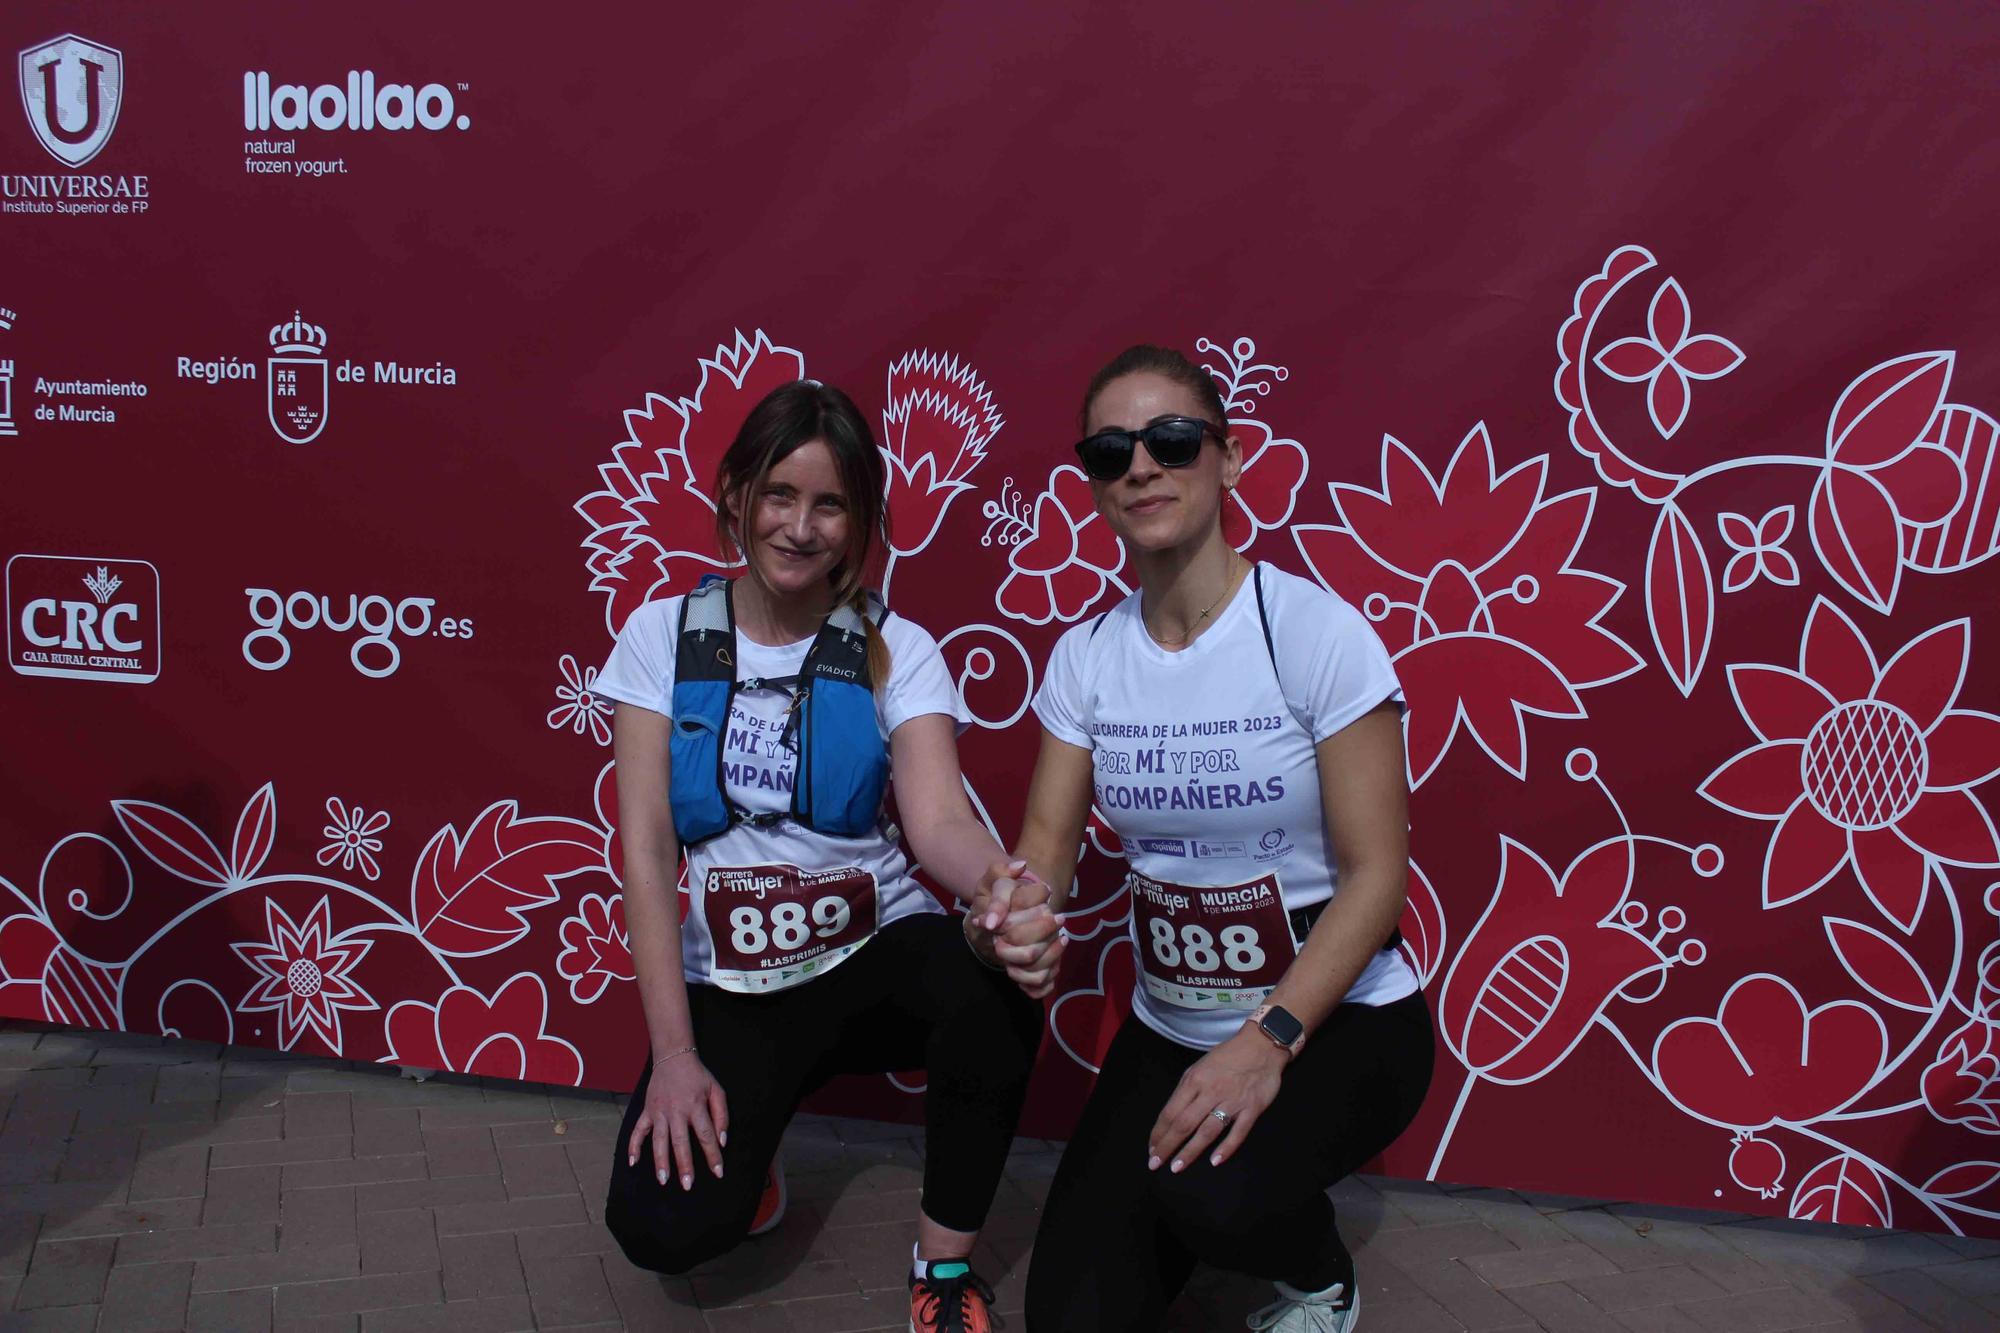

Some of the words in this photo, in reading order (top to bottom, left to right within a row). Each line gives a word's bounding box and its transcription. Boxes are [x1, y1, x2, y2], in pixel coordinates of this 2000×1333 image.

[244, 139, 295, 154] natural
[245, 157, 291, 173] frozen
[295, 158, 348, 177] yogurt.
[1, 175, 149, 197] UNIVERSAE
[3, 201, 53, 213] Instituto
[57, 201, 109, 216] Superior
[112, 201, 128, 213] de
[132, 201, 149, 213] FP
[177, 356, 256, 384] Región
[336, 360, 366, 382] de
[374, 362, 456, 385] Murcia
[35, 377, 147, 397] Ayuntamiento
[35, 404, 55, 420] de
[59, 405, 115, 422] Murcia
[21, 598, 143, 652] CRC
[23, 652, 49, 662] CAJA
[51, 653, 87, 666] RURAL
[88, 656, 142, 669] CENTRAL
[816, 664, 857, 679] EVADICT
[748, 716, 766, 730] DE
[1101, 723, 1149, 738] CARRERA
[1152, 725, 1168, 738] DE
[1172, 724, 1187, 737] LA
[1192, 720, 1238, 736] MUJER
[1243, 715, 1282, 732] 2023
[728, 728, 760, 754] MÍ
[765, 741, 781, 759] Y
[1099, 750, 1131, 774] POR
[1136, 740, 1165, 774] MÍ
[1170, 752, 1187, 774] Y
[1191, 748, 1240, 773] POR
[1105, 775, 1285, 810] COMPAÑERAS
[722, 870, 753, 879] carrera
[818, 873, 846, 884] MARZO
[731, 875, 783, 900] mujer
[1200, 883, 1272, 906] MURCIA
[1147, 890, 1190, 916] mujer
[1222, 903, 1253, 913] MARZO
[1255, 896, 1275, 909] 2023
[729, 895, 851, 954] 889
[1149, 917, 1266, 972] 888
[760, 943, 826, 969] #LASPRIMIS
[1176, 974, 1242, 987] #LASPRIMIS
